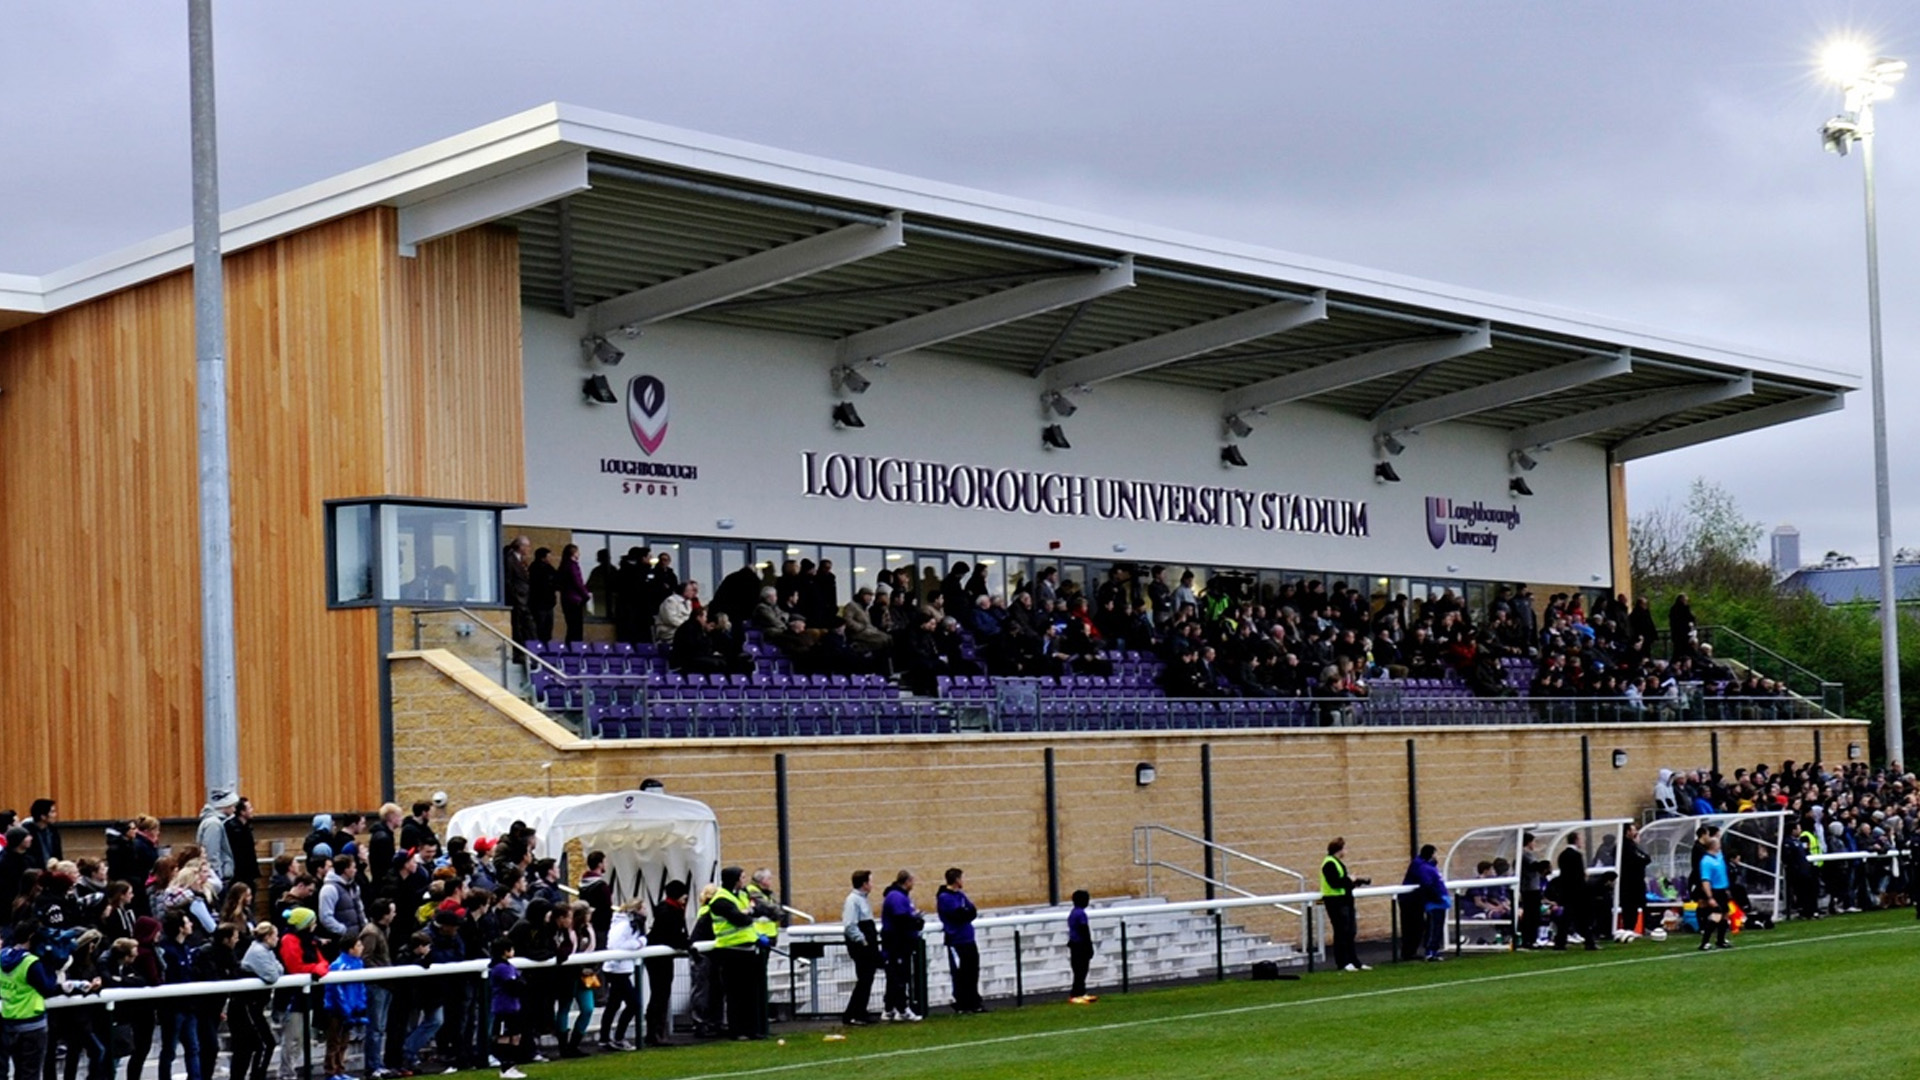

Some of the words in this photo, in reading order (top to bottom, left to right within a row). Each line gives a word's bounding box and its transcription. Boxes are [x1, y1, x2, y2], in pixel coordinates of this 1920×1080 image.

[601, 459, 698, 480] LOUGHBOROUGH
[623, 482, 678, 497] SPORT
[802, 451, 1089, 515] LOUGHBOROUGH
[1093, 478, 1254, 528] UNIVERSITY
[1260, 491, 1369, 537] STADIUM
[1448, 499, 1520, 530] Loughborough
[1449, 524, 1498, 553] University
